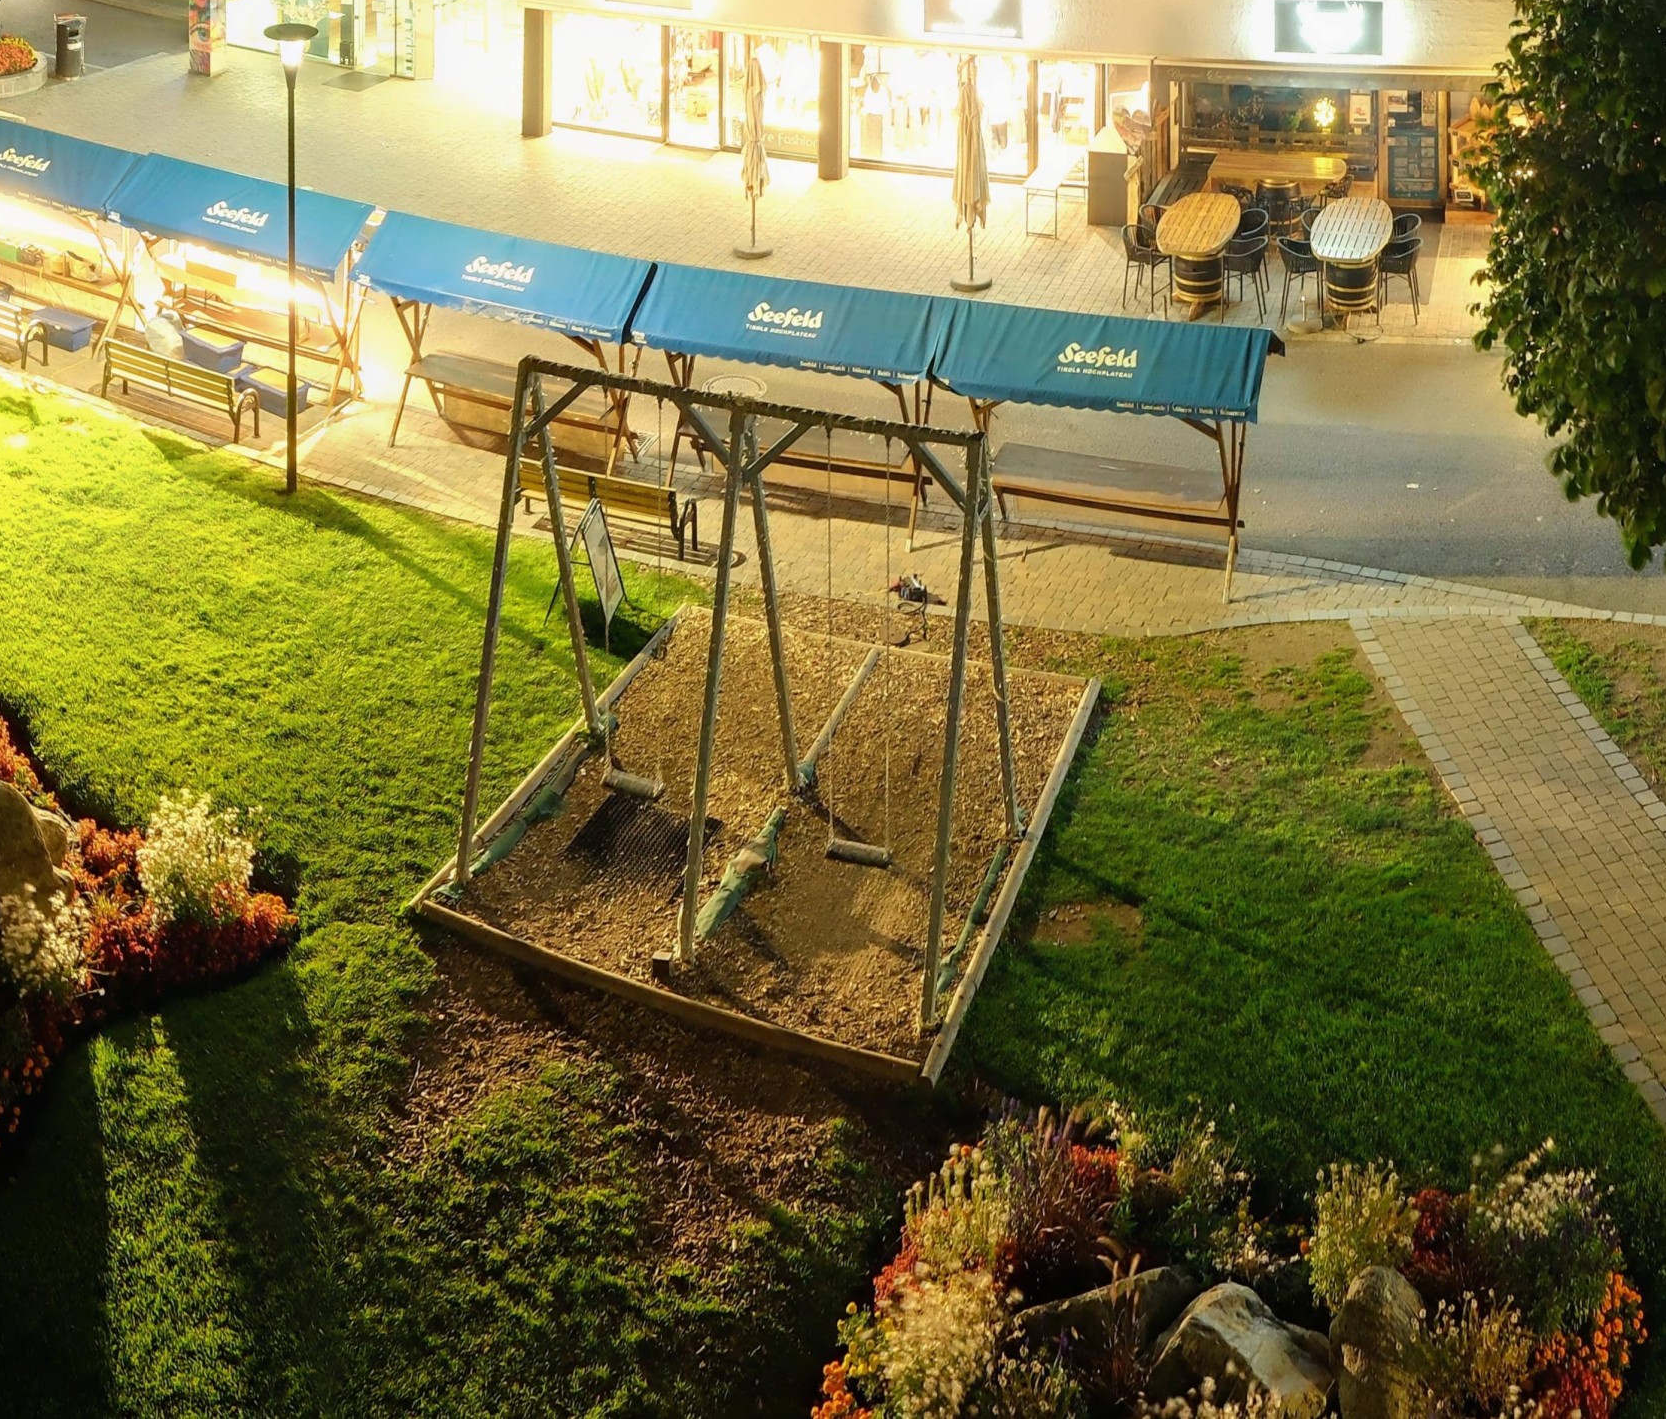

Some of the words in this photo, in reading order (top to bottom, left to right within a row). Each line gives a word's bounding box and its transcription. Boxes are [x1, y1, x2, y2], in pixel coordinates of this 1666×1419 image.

[207, 200, 270, 228] Seefeld
[465, 255, 535, 284] Seefeld
[745, 323, 769, 333] TIROLS
[747, 301, 823, 330] Seefeld
[1058, 342, 1138, 368] Seefeld
[1057, 366, 1081, 374] TIROLS
[1083, 368, 1133, 379] HOCHPLATEAU
